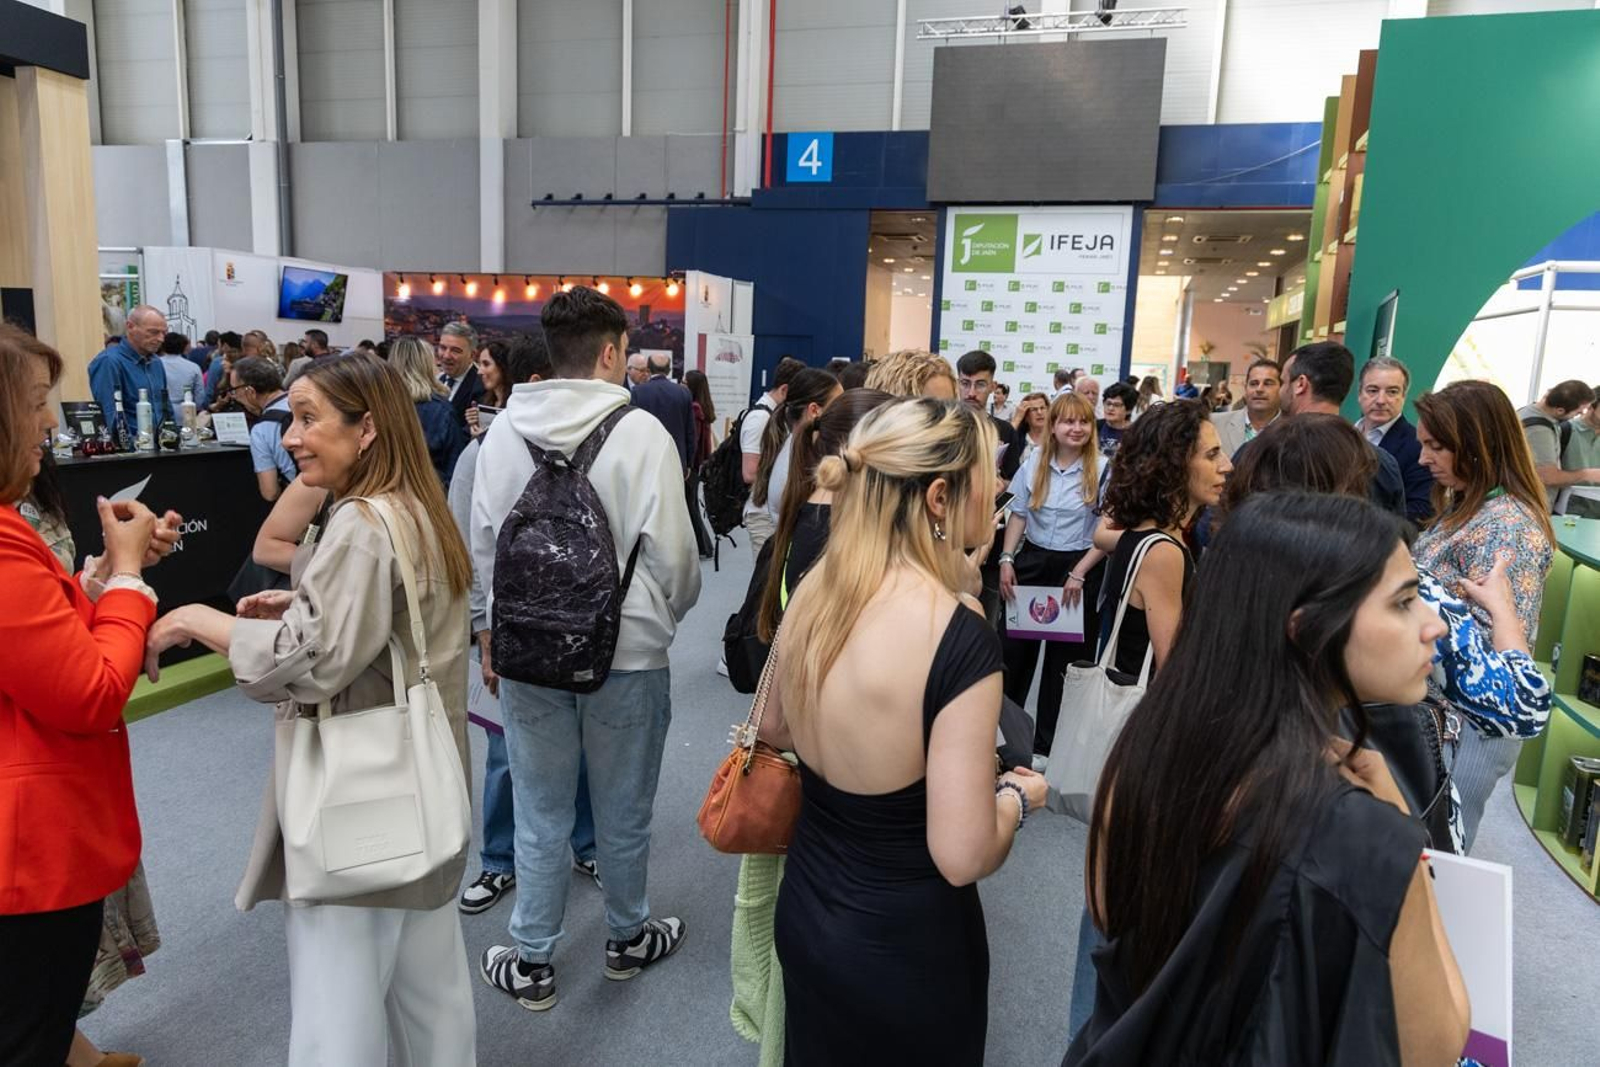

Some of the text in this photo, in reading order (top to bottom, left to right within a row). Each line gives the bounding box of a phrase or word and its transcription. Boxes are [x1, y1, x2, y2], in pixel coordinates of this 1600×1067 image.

[798, 139, 822, 175] 4
[1050, 235, 1114, 250] IFEJA
[177, 519, 208, 535] CIÓN
